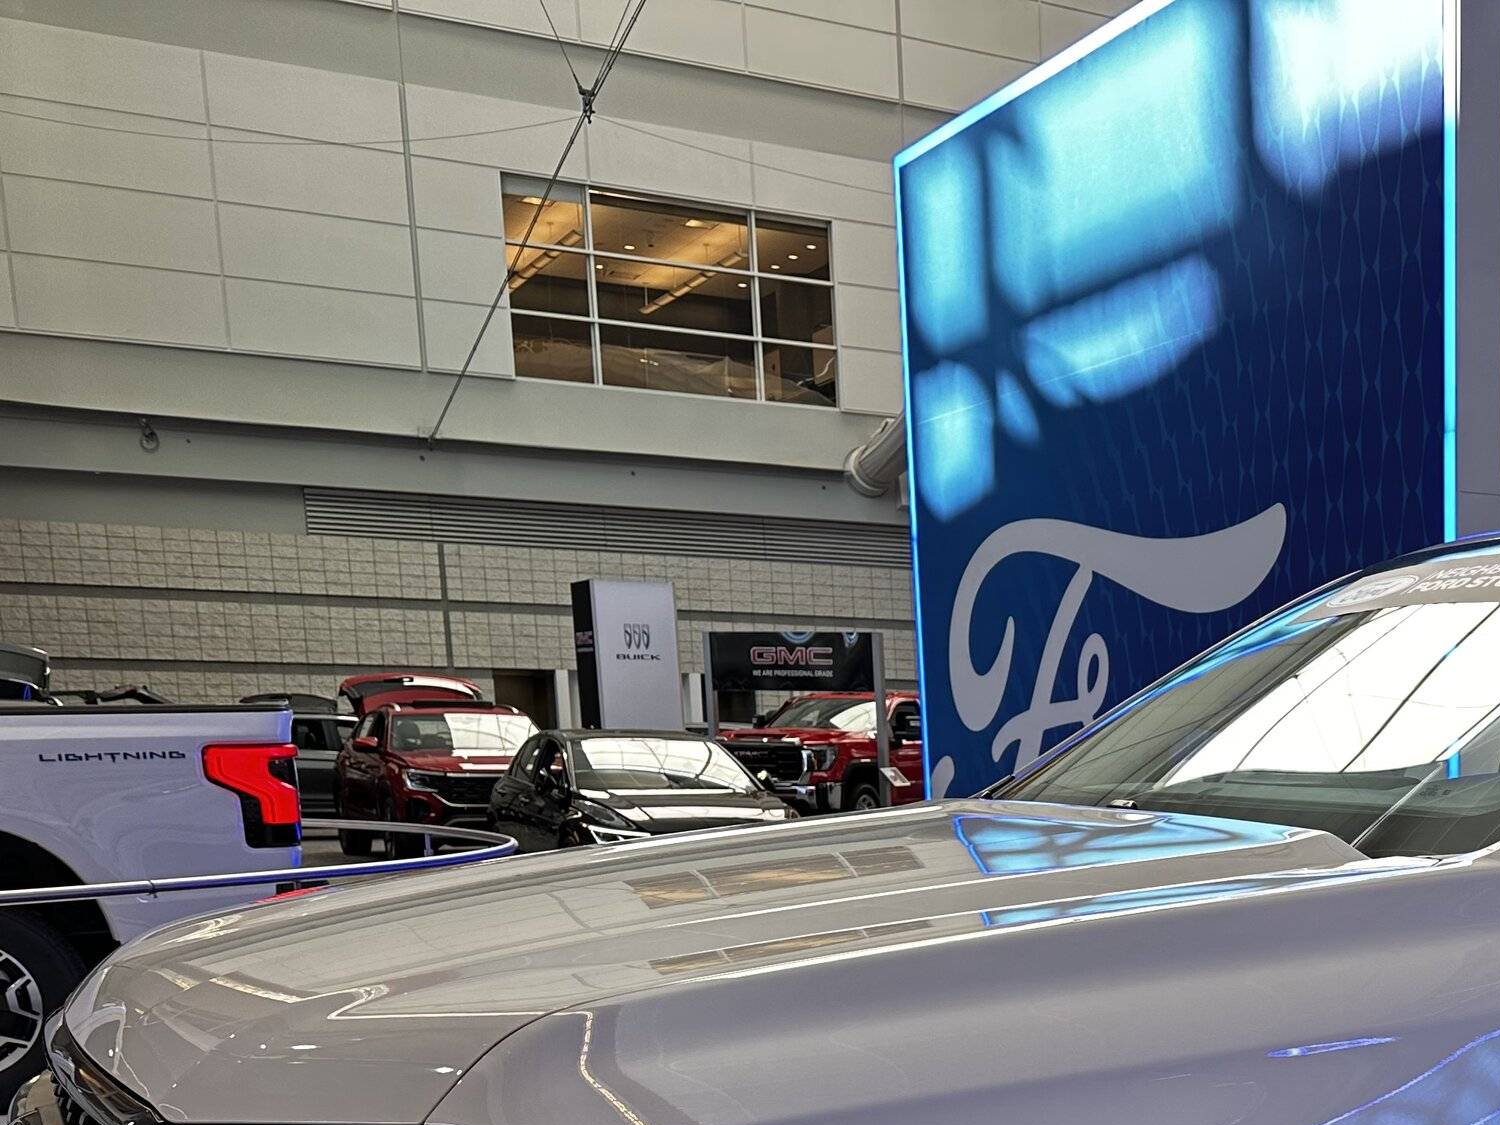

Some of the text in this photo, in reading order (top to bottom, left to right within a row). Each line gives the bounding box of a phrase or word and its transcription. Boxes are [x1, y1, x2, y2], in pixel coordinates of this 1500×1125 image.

[1406, 577, 1472, 594] FORD
[616, 653, 661, 661] BUICK
[750, 646, 833, 665] GMC
[38, 750, 186, 763] LIGHTNING
